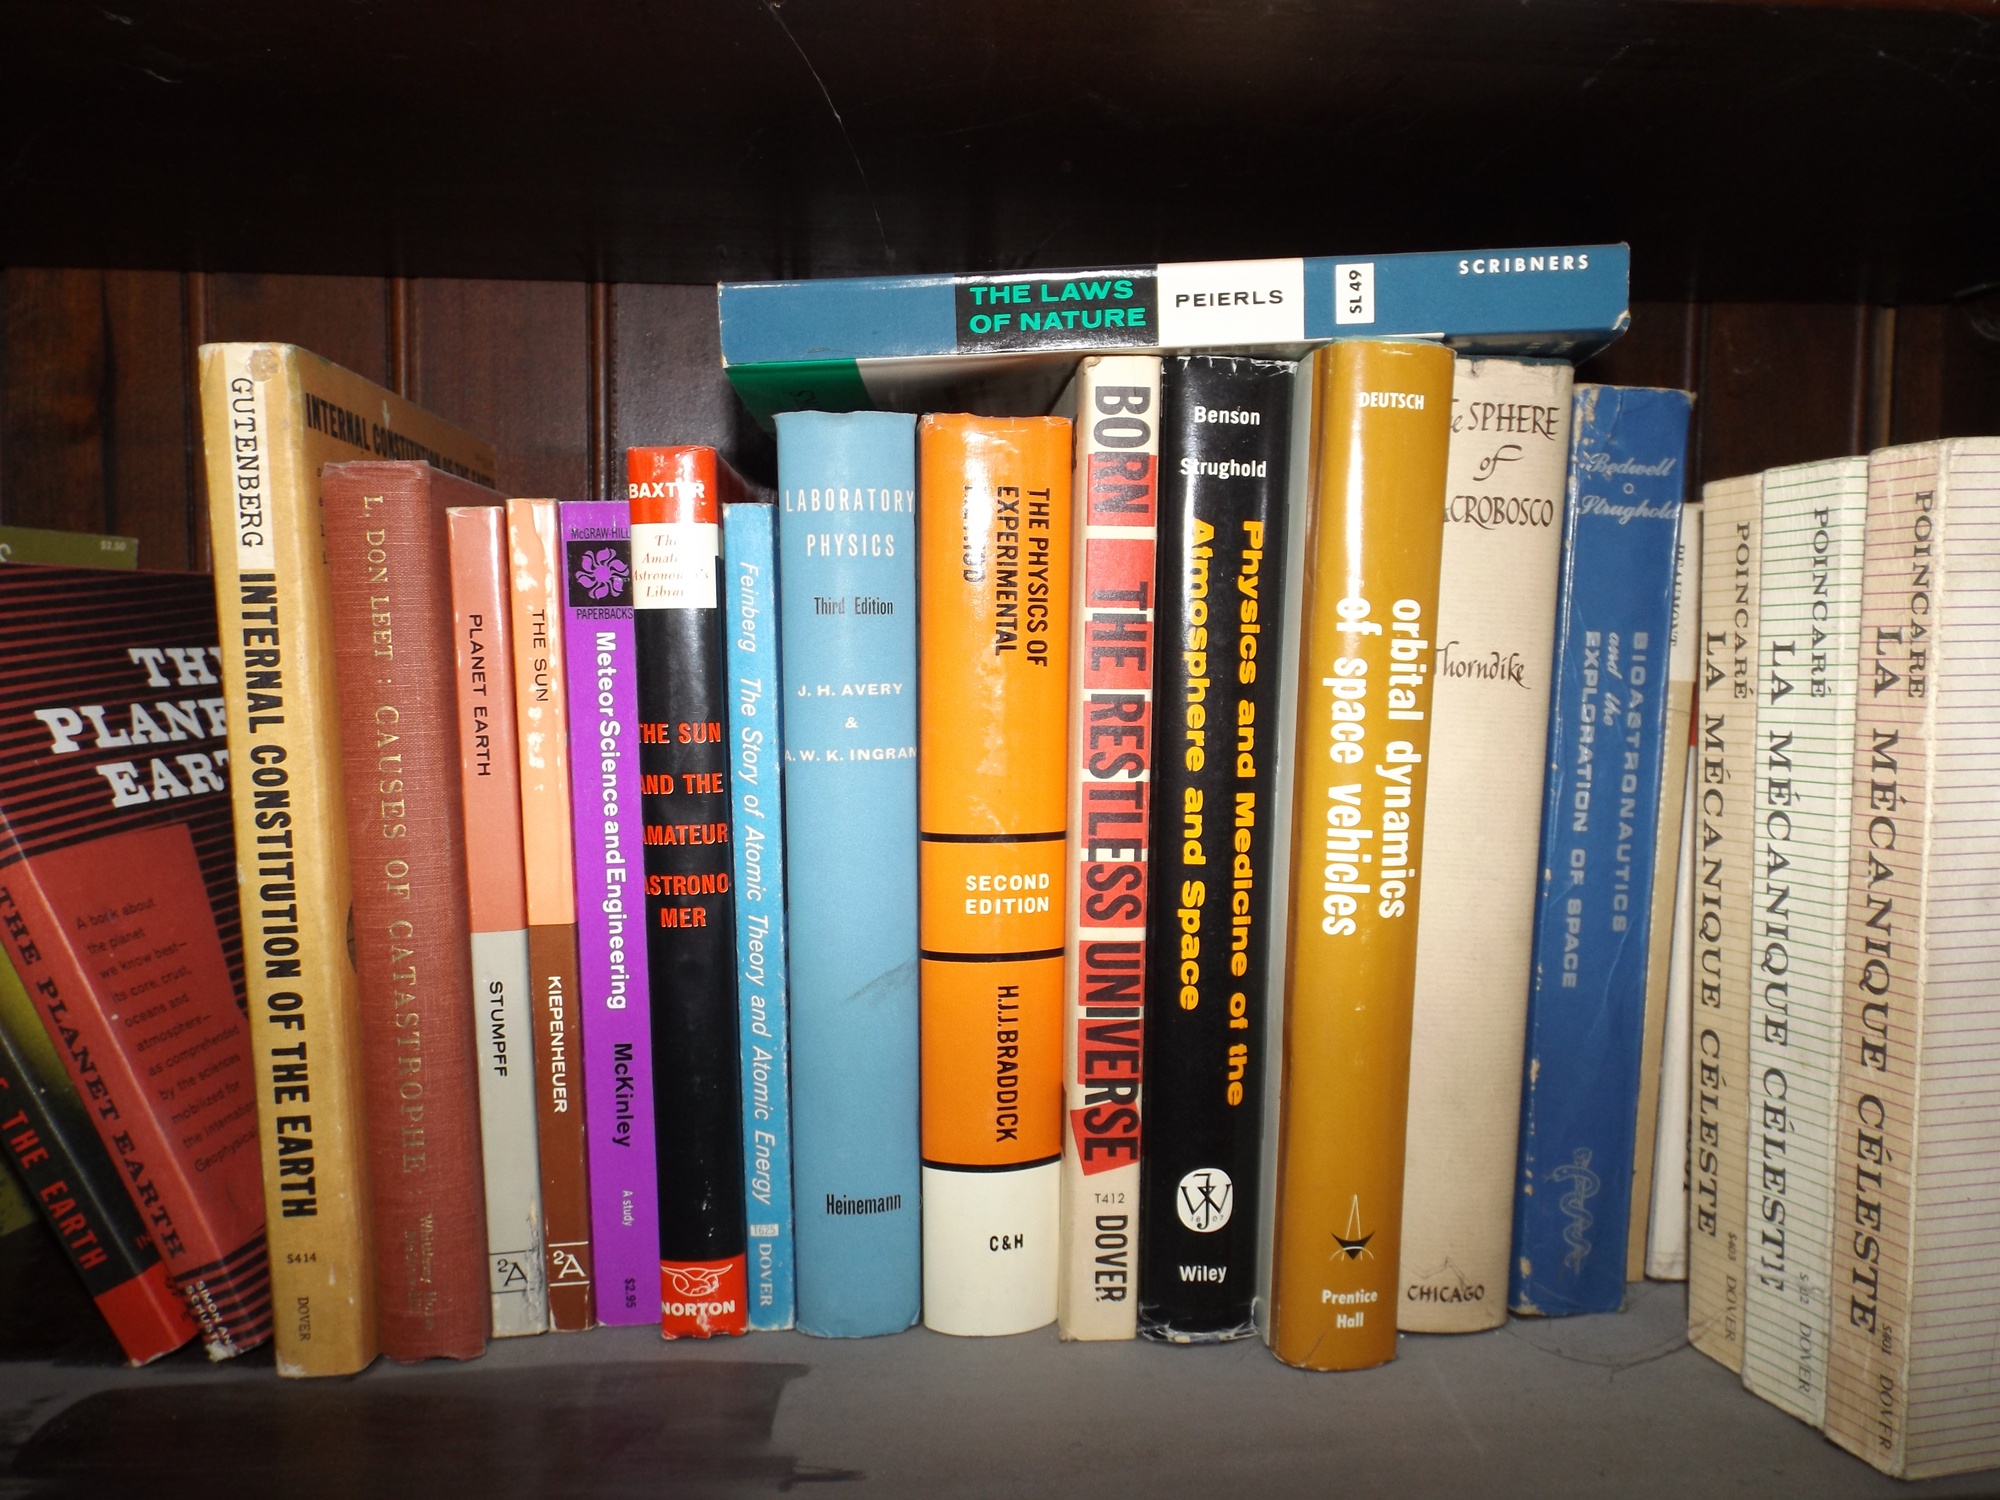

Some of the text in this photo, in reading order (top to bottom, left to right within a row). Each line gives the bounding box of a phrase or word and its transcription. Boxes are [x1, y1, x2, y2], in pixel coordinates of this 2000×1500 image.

[1458, 253, 1590, 275] SCRIBNERS
[969, 279, 1134, 306] THE LAWS
[1175, 289, 1284, 308] PEIERLS
[1348, 269, 1363, 314] SL 49
[969, 306, 1147, 334] OF NATURE
[1194, 405, 1262, 427] Benson
[1359, 391, 1425, 411] DEUTSCH
[1467, 401, 1561, 441] SPHERE
[231, 376, 264, 549] GUTENBERG
[1180, 457, 1268, 480] Strughold
[1472, 444, 1525, 482] of
[629, 481, 706, 500] BAXTR
[785, 488, 915, 513] LABORATORY
[570, 527, 632, 541] McGRAW-HILL
[806, 533, 896, 557] PHYSICS
[365, 528, 389, 584] DON
[994, 485, 1020, 657] EXPERIMENTAL
[1026, 487, 1051, 668] THE PHYSICS OF
[576, 606, 634, 621] PAPERBACKS
[814, 596, 894, 615] Third Edition
[1733, 521, 1755, 700] POINCARÉ
[1810, 505, 1833, 699] POINCARÉ
[370, 595, 395, 661] LEET
[531, 608, 550, 703] THE SUN
[468, 613, 492, 778] PLANET EARTH
[797, 683, 904, 697] J. H. AVERY
[1603, 631, 1625, 728] and the
[678, 722, 722, 743] SUN
[844, 716, 859, 729] &
[374, 705, 407, 841] CAUSES
[799, 749, 820, 762] W.
[826, 749, 844, 762] K.
[1082, 385, 1152, 1163] BORN THE RESTLESS UNIVERSE
[1176, 517, 1216, 1011] Atmosphere and Space
[1321, 597, 1383, 937] of space vehicles
[1374, 598, 1429, 919] orbital dynamics
[682, 771, 724, 795] THE
[1612, 631, 1650, 934] BIOASTRONAUTICS
[595, 631, 629, 1012] Meteor Science and Engineering
[1226, 520, 1266, 1107] Physics and Medicine of the
[1562, 630, 1602, 990] EXPLORATION OF SPACE
[1760, 639, 1801, 1048] LA MÉCANIQUE
[239, 573, 318, 1218] INTERNAL CONSTITUTION OF THE EARTH
[385, 858, 411, 902] OF
[737, 561, 777, 1206] Feinberg The Story of Atomic Theory and Atomic Energy
[964, 872, 1051, 892] SECOND
[121, 897, 157, 917] about
[660, 907, 707, 928] MER
[964, 896, 1051, 915] EDITION
[86, 927, 146, 955] the planet
[1697, 631, 1731, 1239] LA MÉCANIQUE CÉLESTE
[99, 966, 120, 980] we
[1849, 625, 1909, 1336] LA MÉCANIQUE CÉLESTE
[123, 991, 190, 1029] oceans and
[488, 980, 508, 1079] STUMPFF
[388, 919, 428, 1175] CATASTROPHE
[547, 975, 569, 1114] KIEPENHEUER
[0, 886, 42, 967] THE
[36, 975, 122, 1122] PLANET
[111, 1129, 187, 1260] EARTH
[149, 1063, 164, 1078] as
[158, 1084, 176, 1101] by
[177, 1076, 196, 1092] the
[996, 1030, 1020, 1143] BRADDICK
[611, 1042, 633, 1149] McKinley
[182, 1131, 203, 1149] the
[1, 1109, 109, 1272] THE EARTH
[825, 1193, 902, 1216] Heinemann
[1094, 1193, 1126, 1205] T412
[620, 1199, 633, 1228] study
[752, 1224, 777, 1236] T625
[286, 1252, 317, 1265] S414
[758, 1243, 774, 1307] DOVER
[1095, 1214, 1129, 1303] DOVER
[1179, 1264, 1228, 1284] Wiley
[195, 1279, 224, 1325] SIMON
[661, 1299, 736, 1317] NORTON
[1321, 1288, 1378, 1306] Prentice
[1407, 1284, 1486, 1304] CHICAGO
[1724, 1274, 1737, 1344] DOVER
[296, 1295, 312, 1342] DOVER
[1336, 1311, 1365, 1329] Hall
[1797, 1322, 1813, 1395] DOVER
